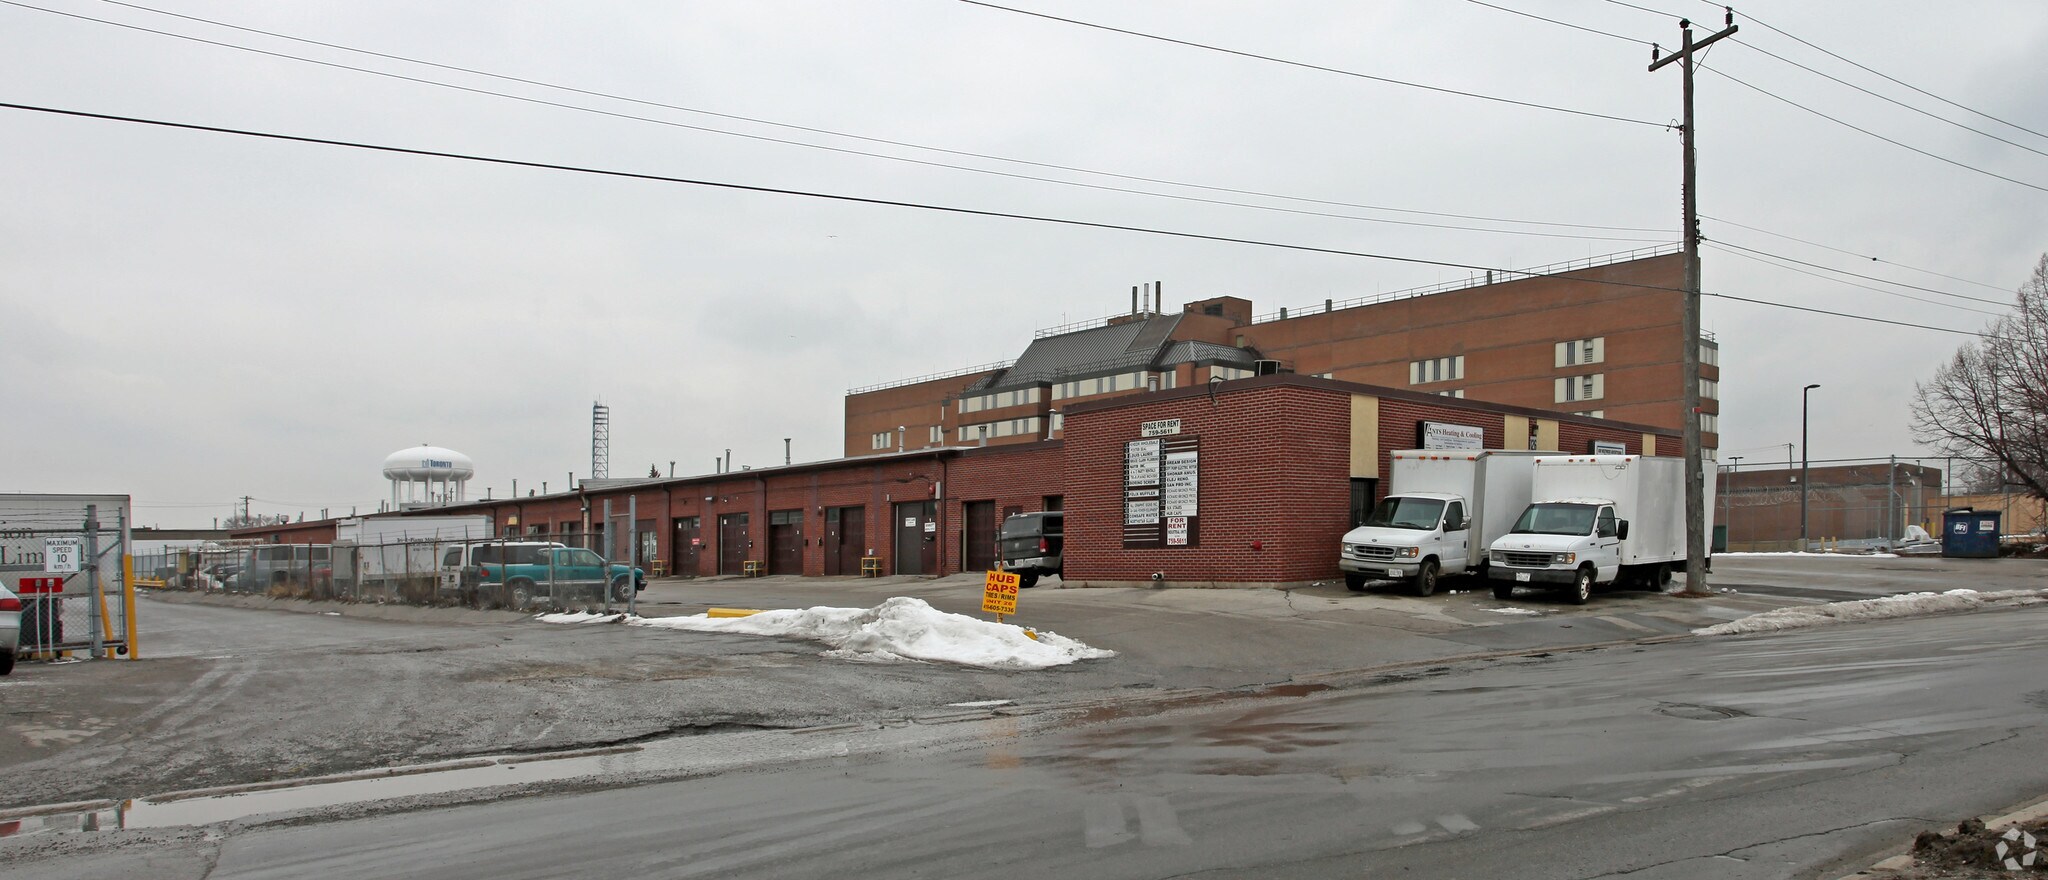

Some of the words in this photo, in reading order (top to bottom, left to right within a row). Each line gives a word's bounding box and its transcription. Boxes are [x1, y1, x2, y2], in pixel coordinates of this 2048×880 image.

[1143, 422, 1157, 430] SPACE
[1442, 429, 1460, 438] Heating
[1465, 431, 1482, 440] Cooling
[57, 554, 67, 563] 10
[989, 573, 1015, 584] HUB
[986, 583, 1018, 594] CAPS
